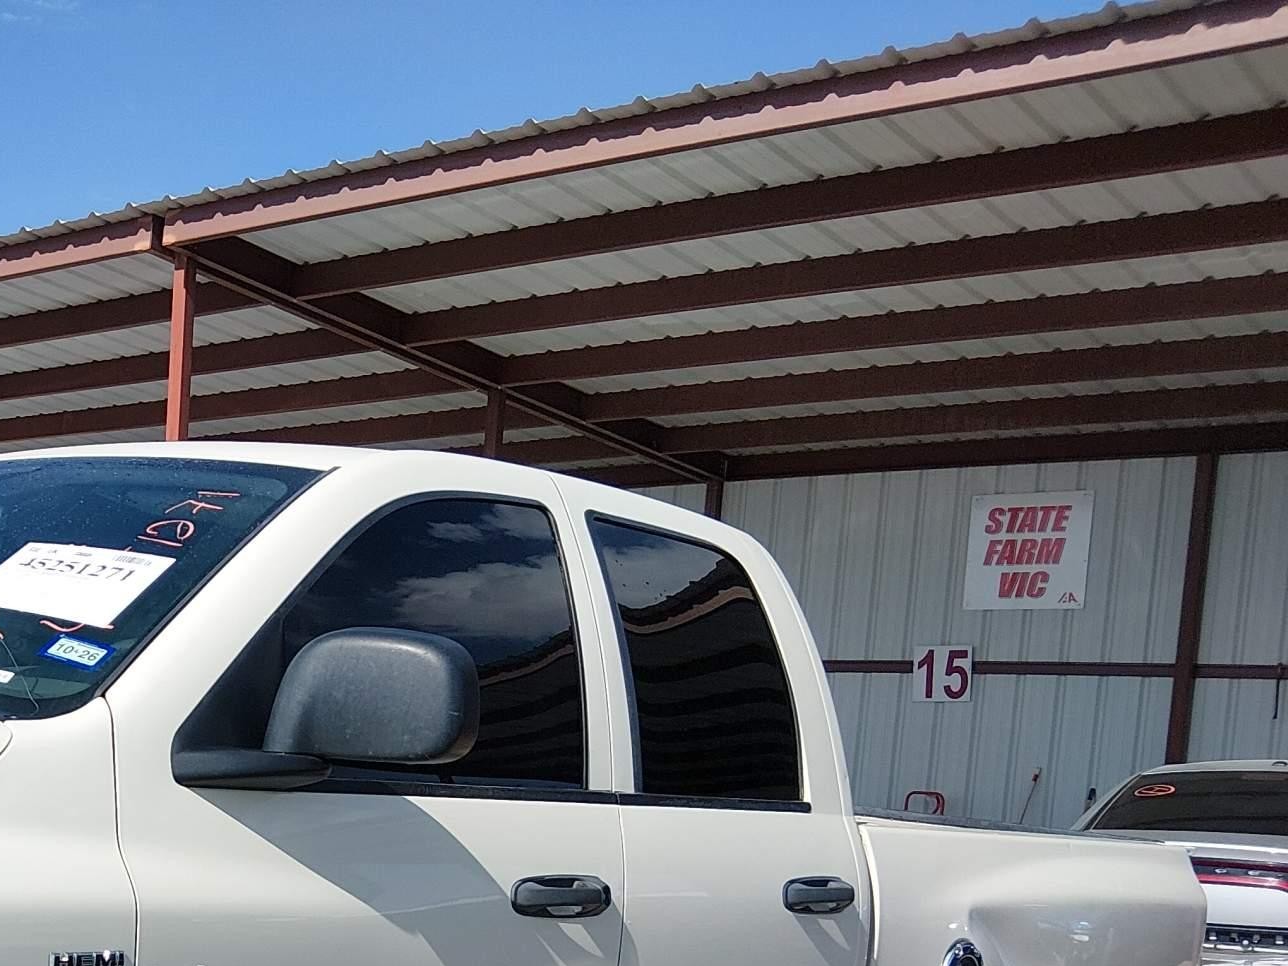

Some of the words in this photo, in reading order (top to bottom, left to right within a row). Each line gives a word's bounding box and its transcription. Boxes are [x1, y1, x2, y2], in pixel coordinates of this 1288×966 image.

[984, 505, 1073, 534] STATE
[983, 538, 1066, 567] FARM
[998, 571, 1050, 599] VIC
[917, 649, 969, 700] 15
